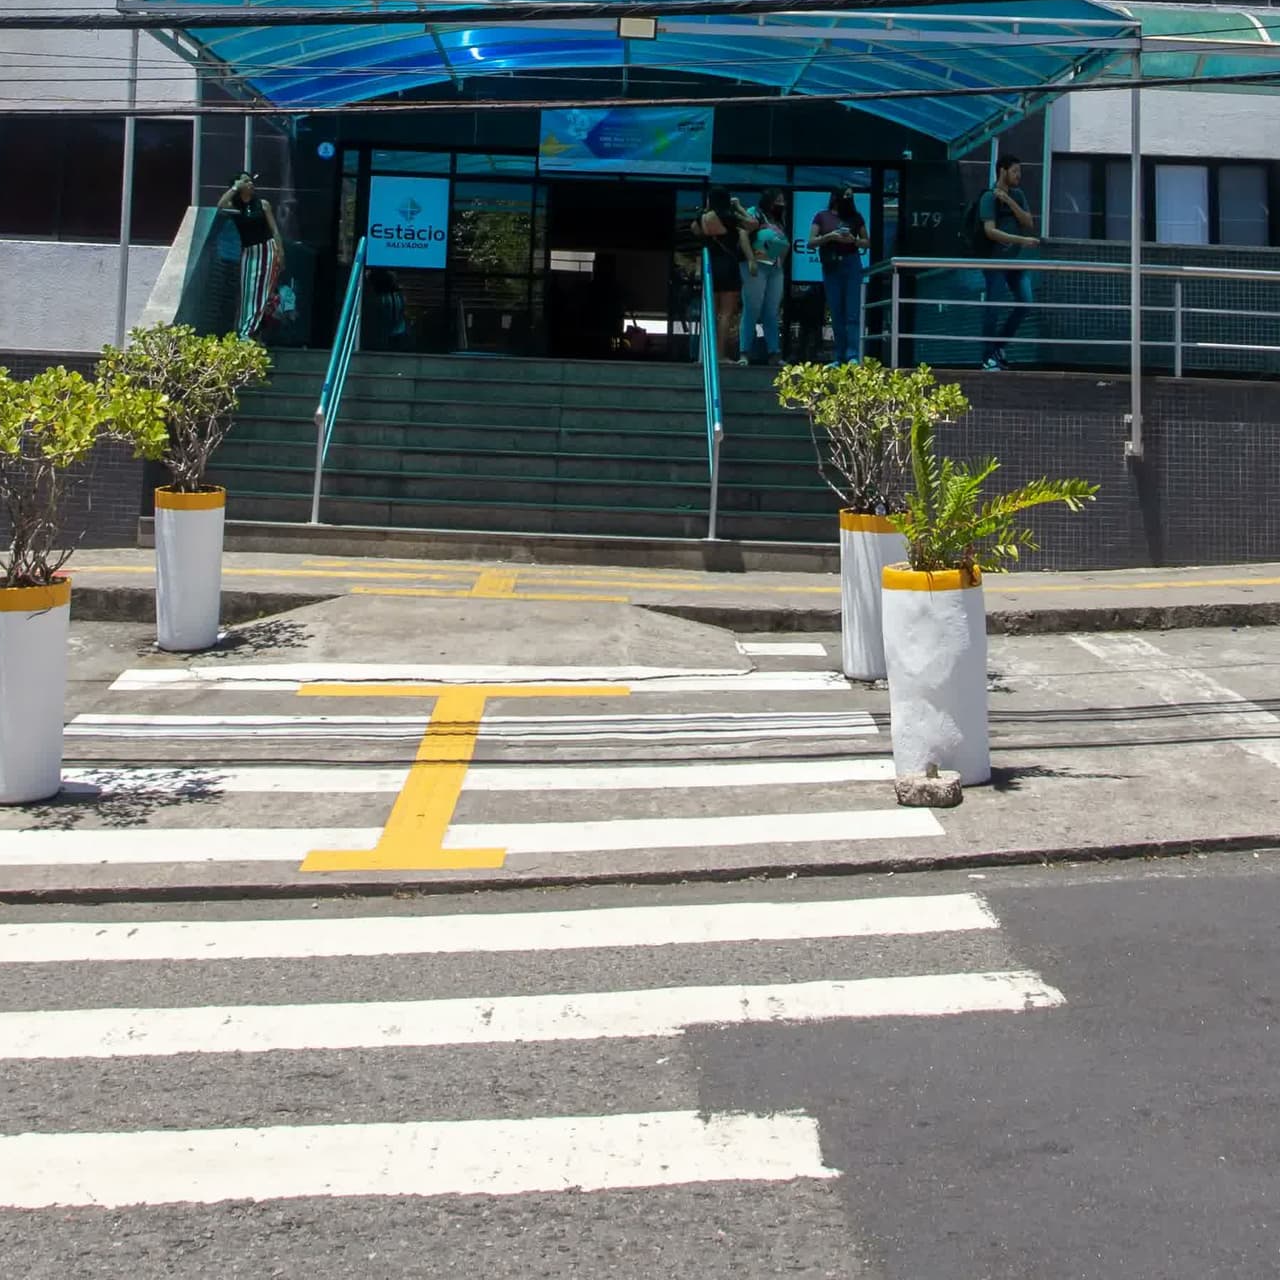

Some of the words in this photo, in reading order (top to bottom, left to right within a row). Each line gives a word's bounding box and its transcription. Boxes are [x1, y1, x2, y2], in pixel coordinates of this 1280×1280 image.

[911, 211, 942, 228] 179
[370, 223, 445, 241] Estácio
[386, 241, 429, 249] SALVADOR
